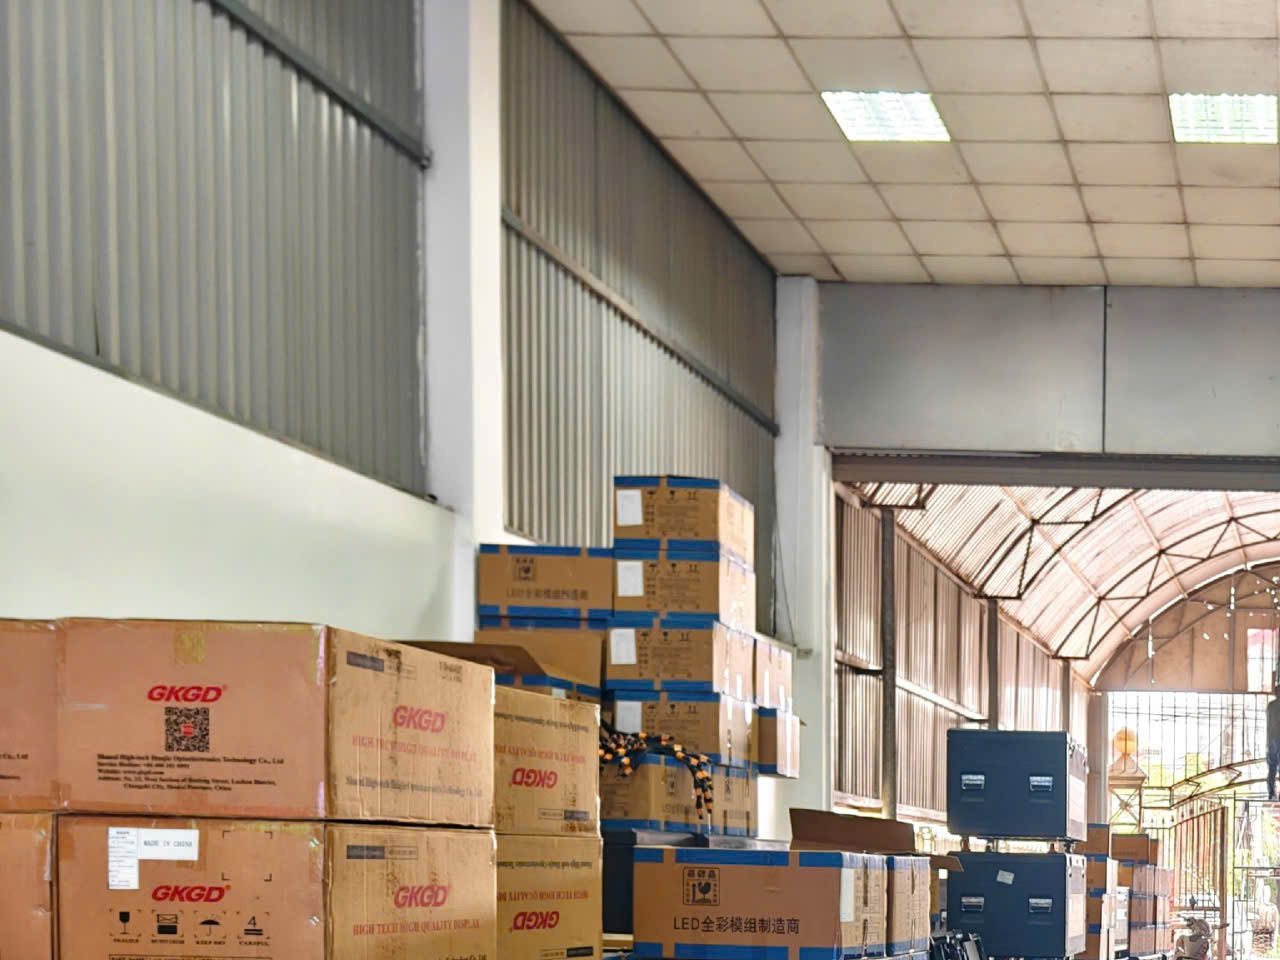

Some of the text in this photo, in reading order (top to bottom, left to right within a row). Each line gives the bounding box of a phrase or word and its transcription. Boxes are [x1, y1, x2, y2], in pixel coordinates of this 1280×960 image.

[147, 685, 222, 702] GKGD
[392, 704, 446, 734] GKGD
[512, 768, 558, 789] GKGD
[152, 884, 225, 902] GKGD
[394, 884, 449, 910] GKGD
[353, 922, 374, 936] HIGH
[421, 920, 452, 934] QUALITY
[512, 910, 560, 930] GKGD
[673, 916, 800, 934] LED全彩模组制造商
